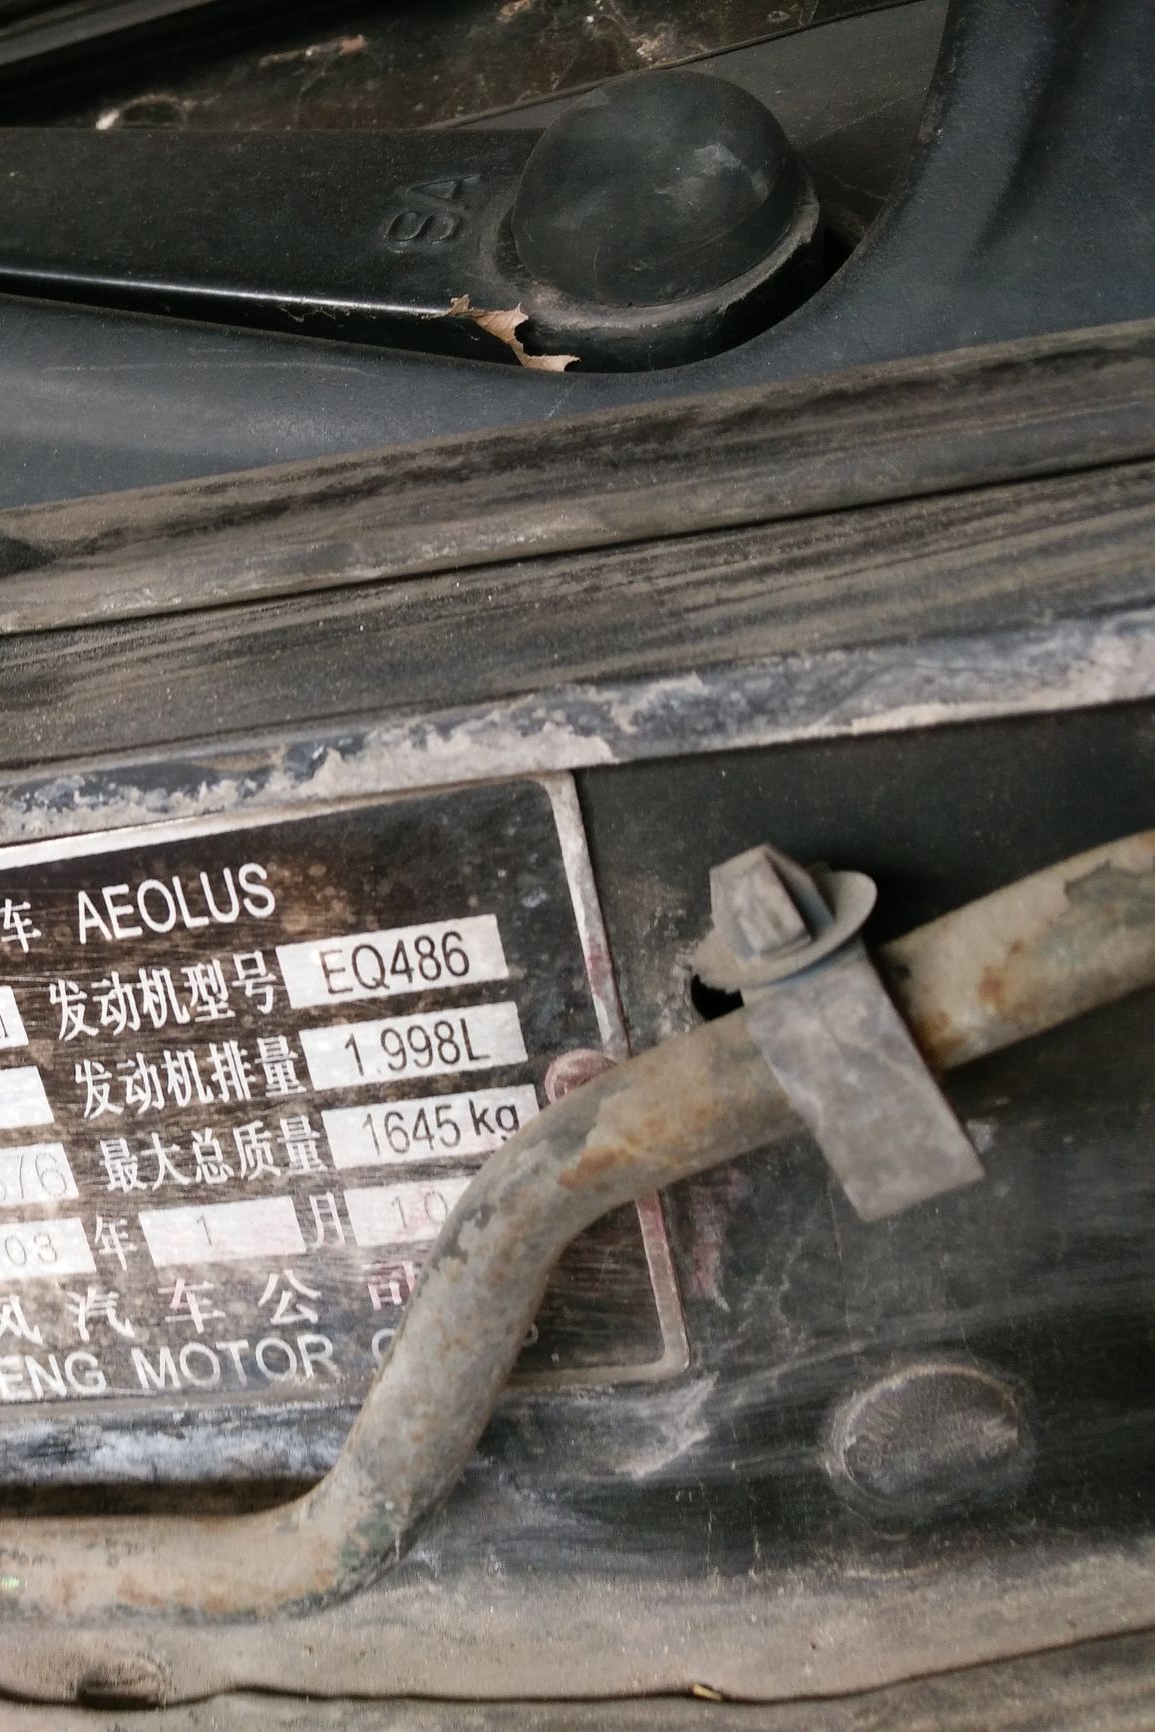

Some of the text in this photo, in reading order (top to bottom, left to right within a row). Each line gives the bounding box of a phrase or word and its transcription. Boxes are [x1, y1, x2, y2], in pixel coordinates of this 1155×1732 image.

[77, 863, 276, 944] AEOLUS
[48, 930, 470, 1041] 发动机型号 EQ486
[74, 1017, 491, 1120] 发动机排量 1.998L
[98, 1114, 329, 1193] 最大总质量
[362, 1105, 461, 1156] 1645
[95, 1214, 137, 1271] 年
[195, 1213, 214, 1247] 1
[308, 1191, 346, 1248] 月
[130, 1333, 341, 1390] MOTOR
